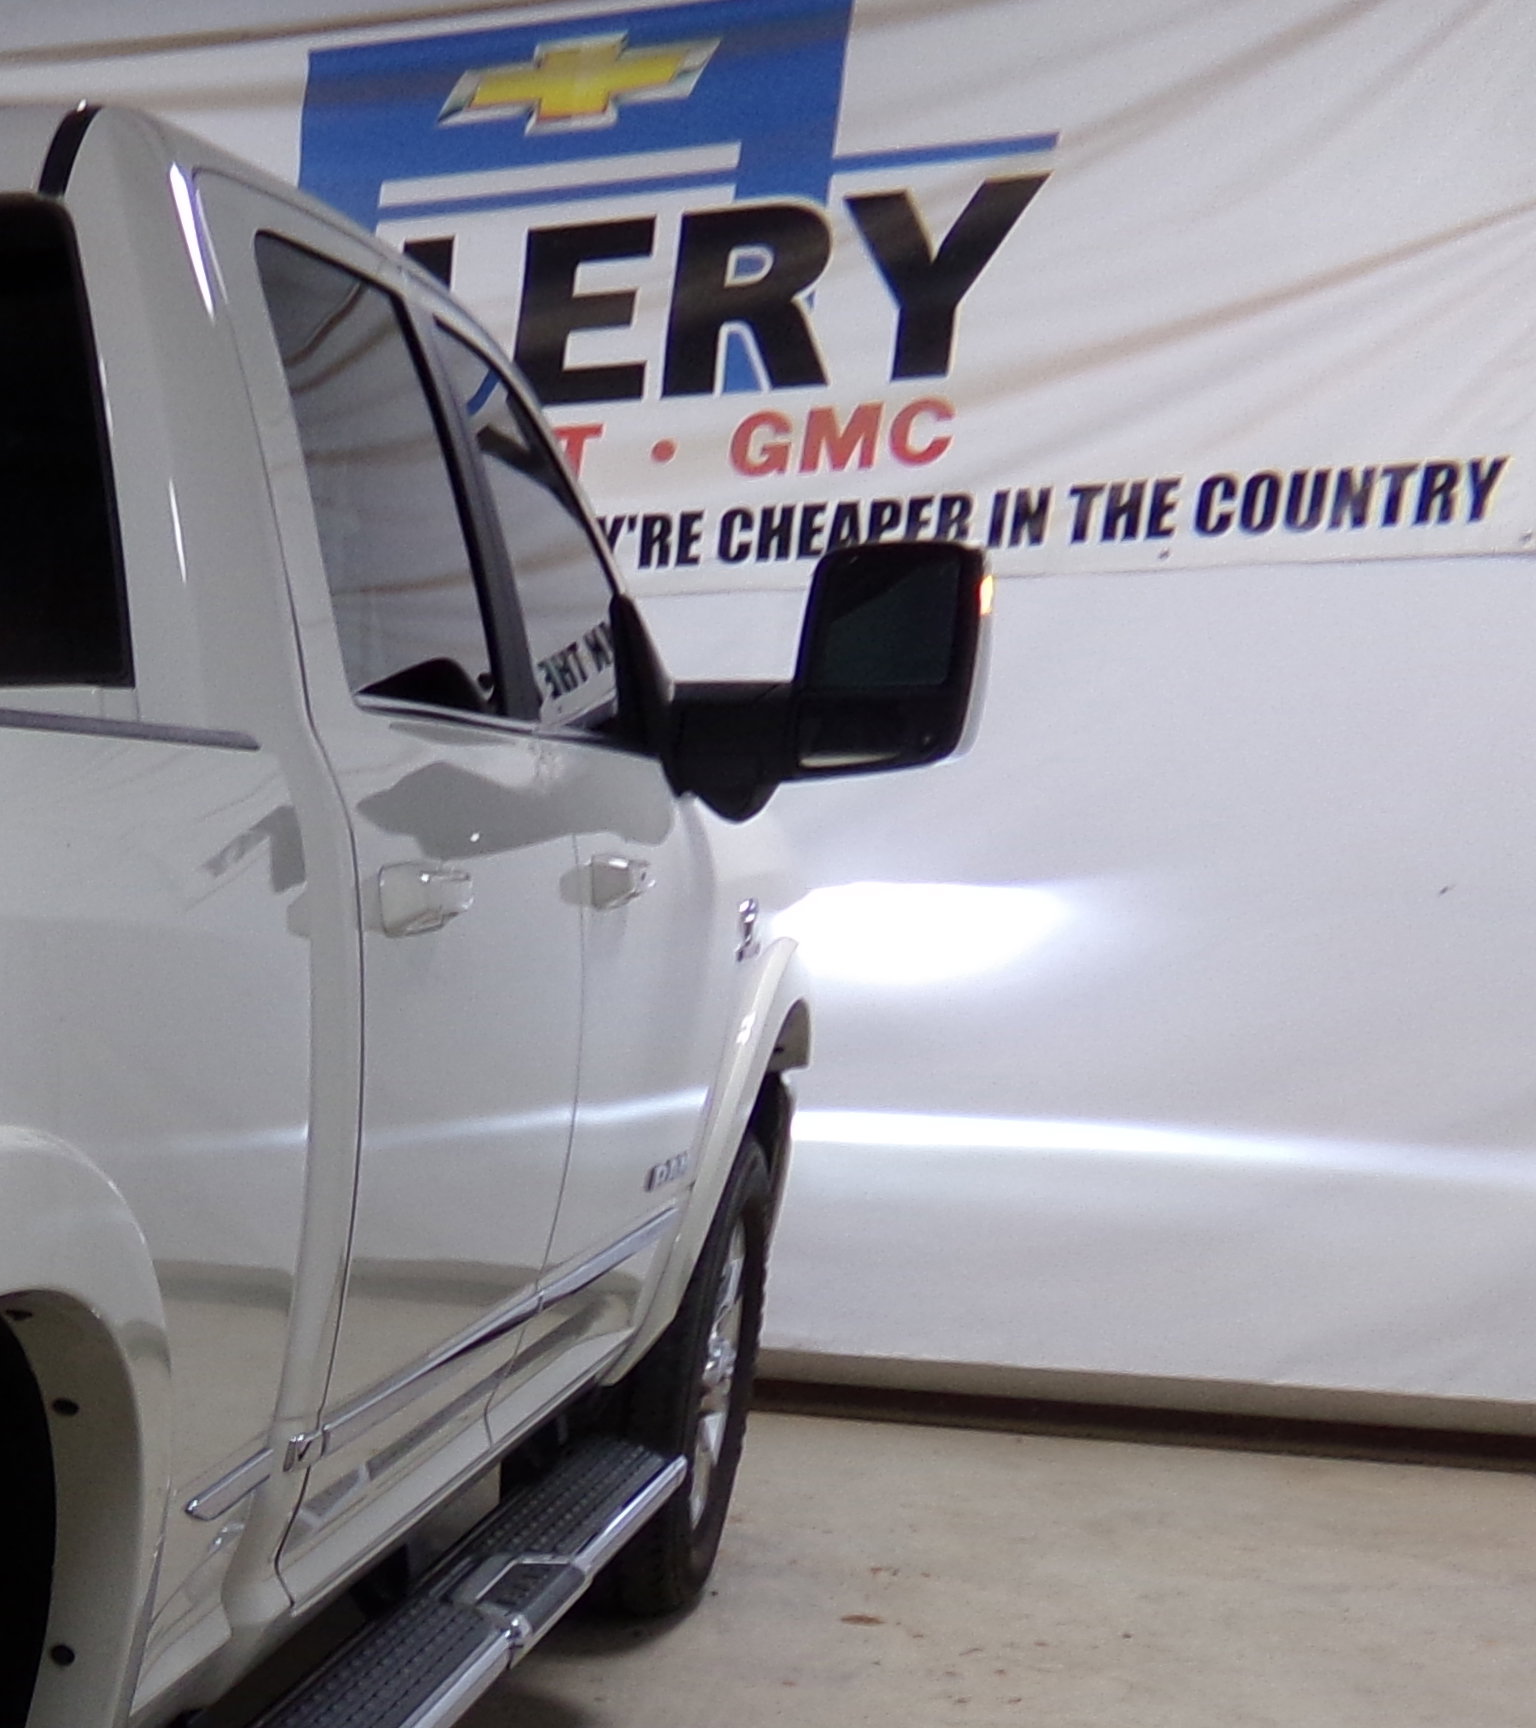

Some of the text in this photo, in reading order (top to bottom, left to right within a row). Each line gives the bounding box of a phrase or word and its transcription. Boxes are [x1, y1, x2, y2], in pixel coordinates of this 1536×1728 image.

[402, 172, 1053, 405] ERY
[728, 398, 956, 478] GMC
[986, 488, 1051, 548] IN
[1066, 476, 1178, 543] THE
[1193, 455, 1511, 535] COUNTRY
